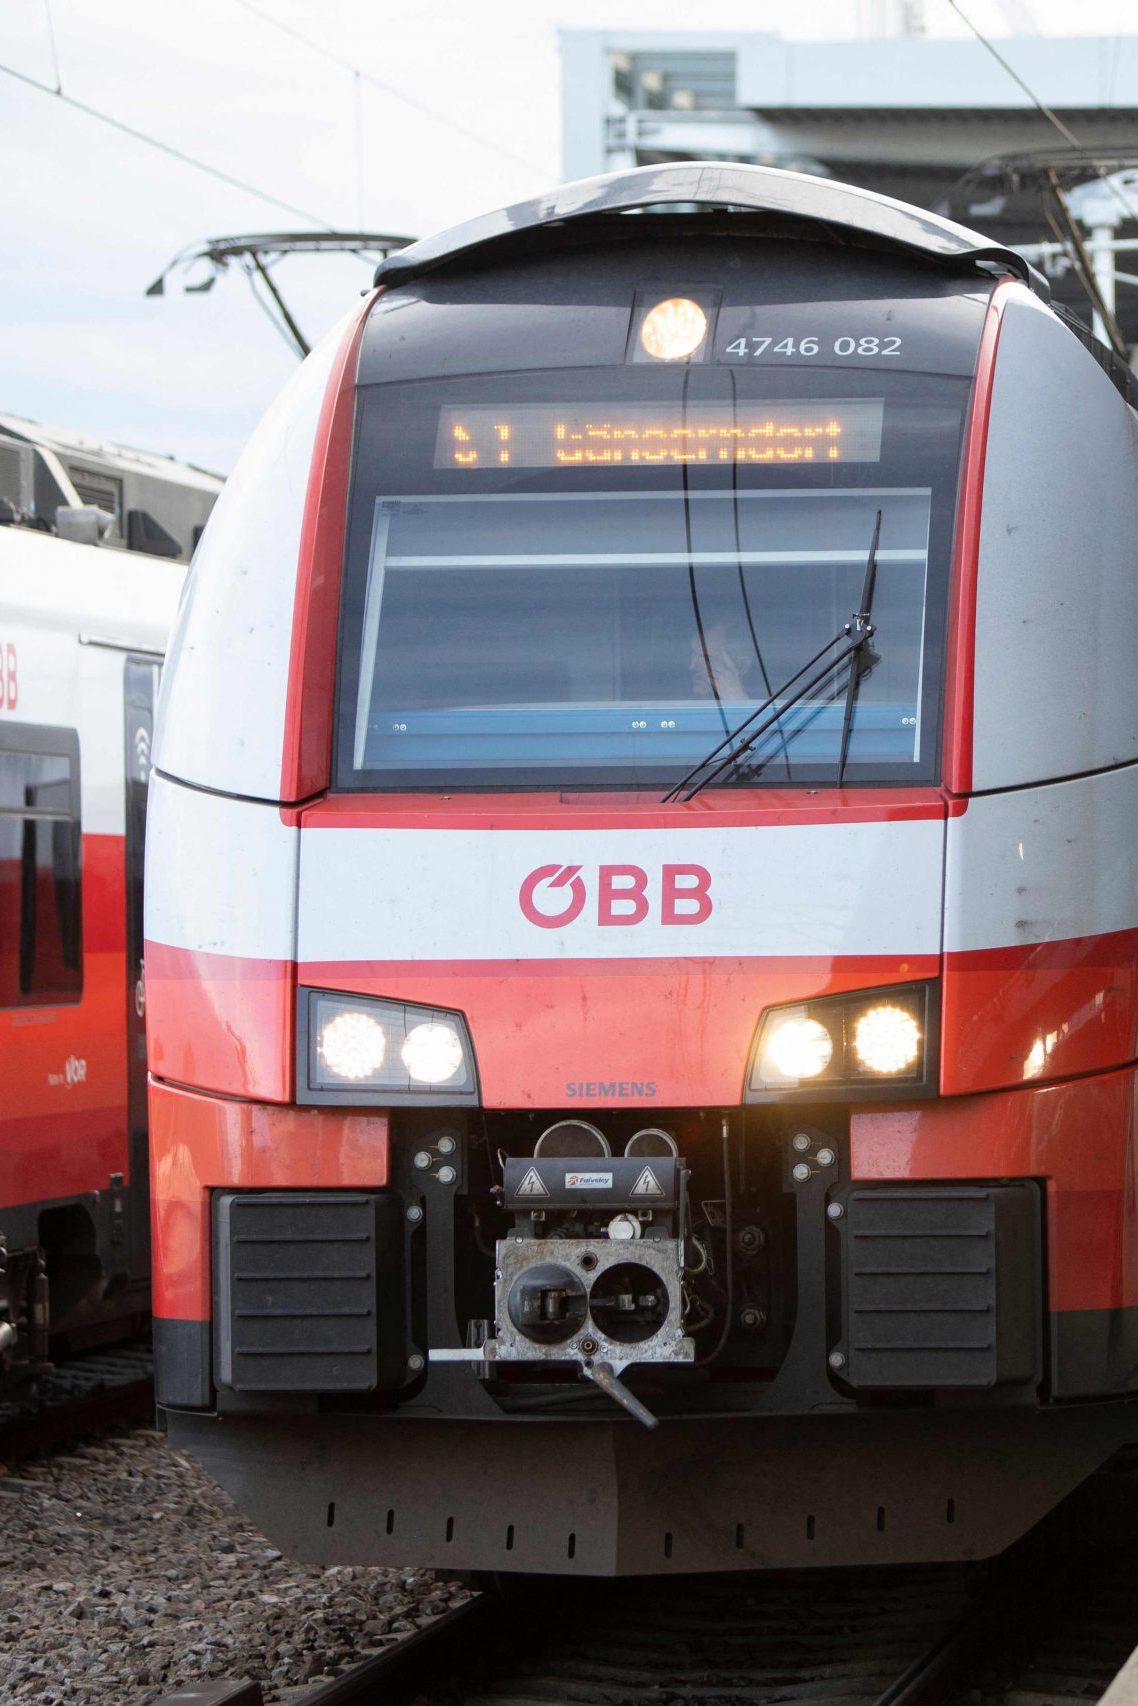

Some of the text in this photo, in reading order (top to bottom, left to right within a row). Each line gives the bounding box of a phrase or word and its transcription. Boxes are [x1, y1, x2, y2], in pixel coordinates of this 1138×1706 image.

[725, 336, 902, 356] 4746 082
[519, 863, 713, 929] ÖBB
[564, 1081, 657, 1098] SIEMENS
